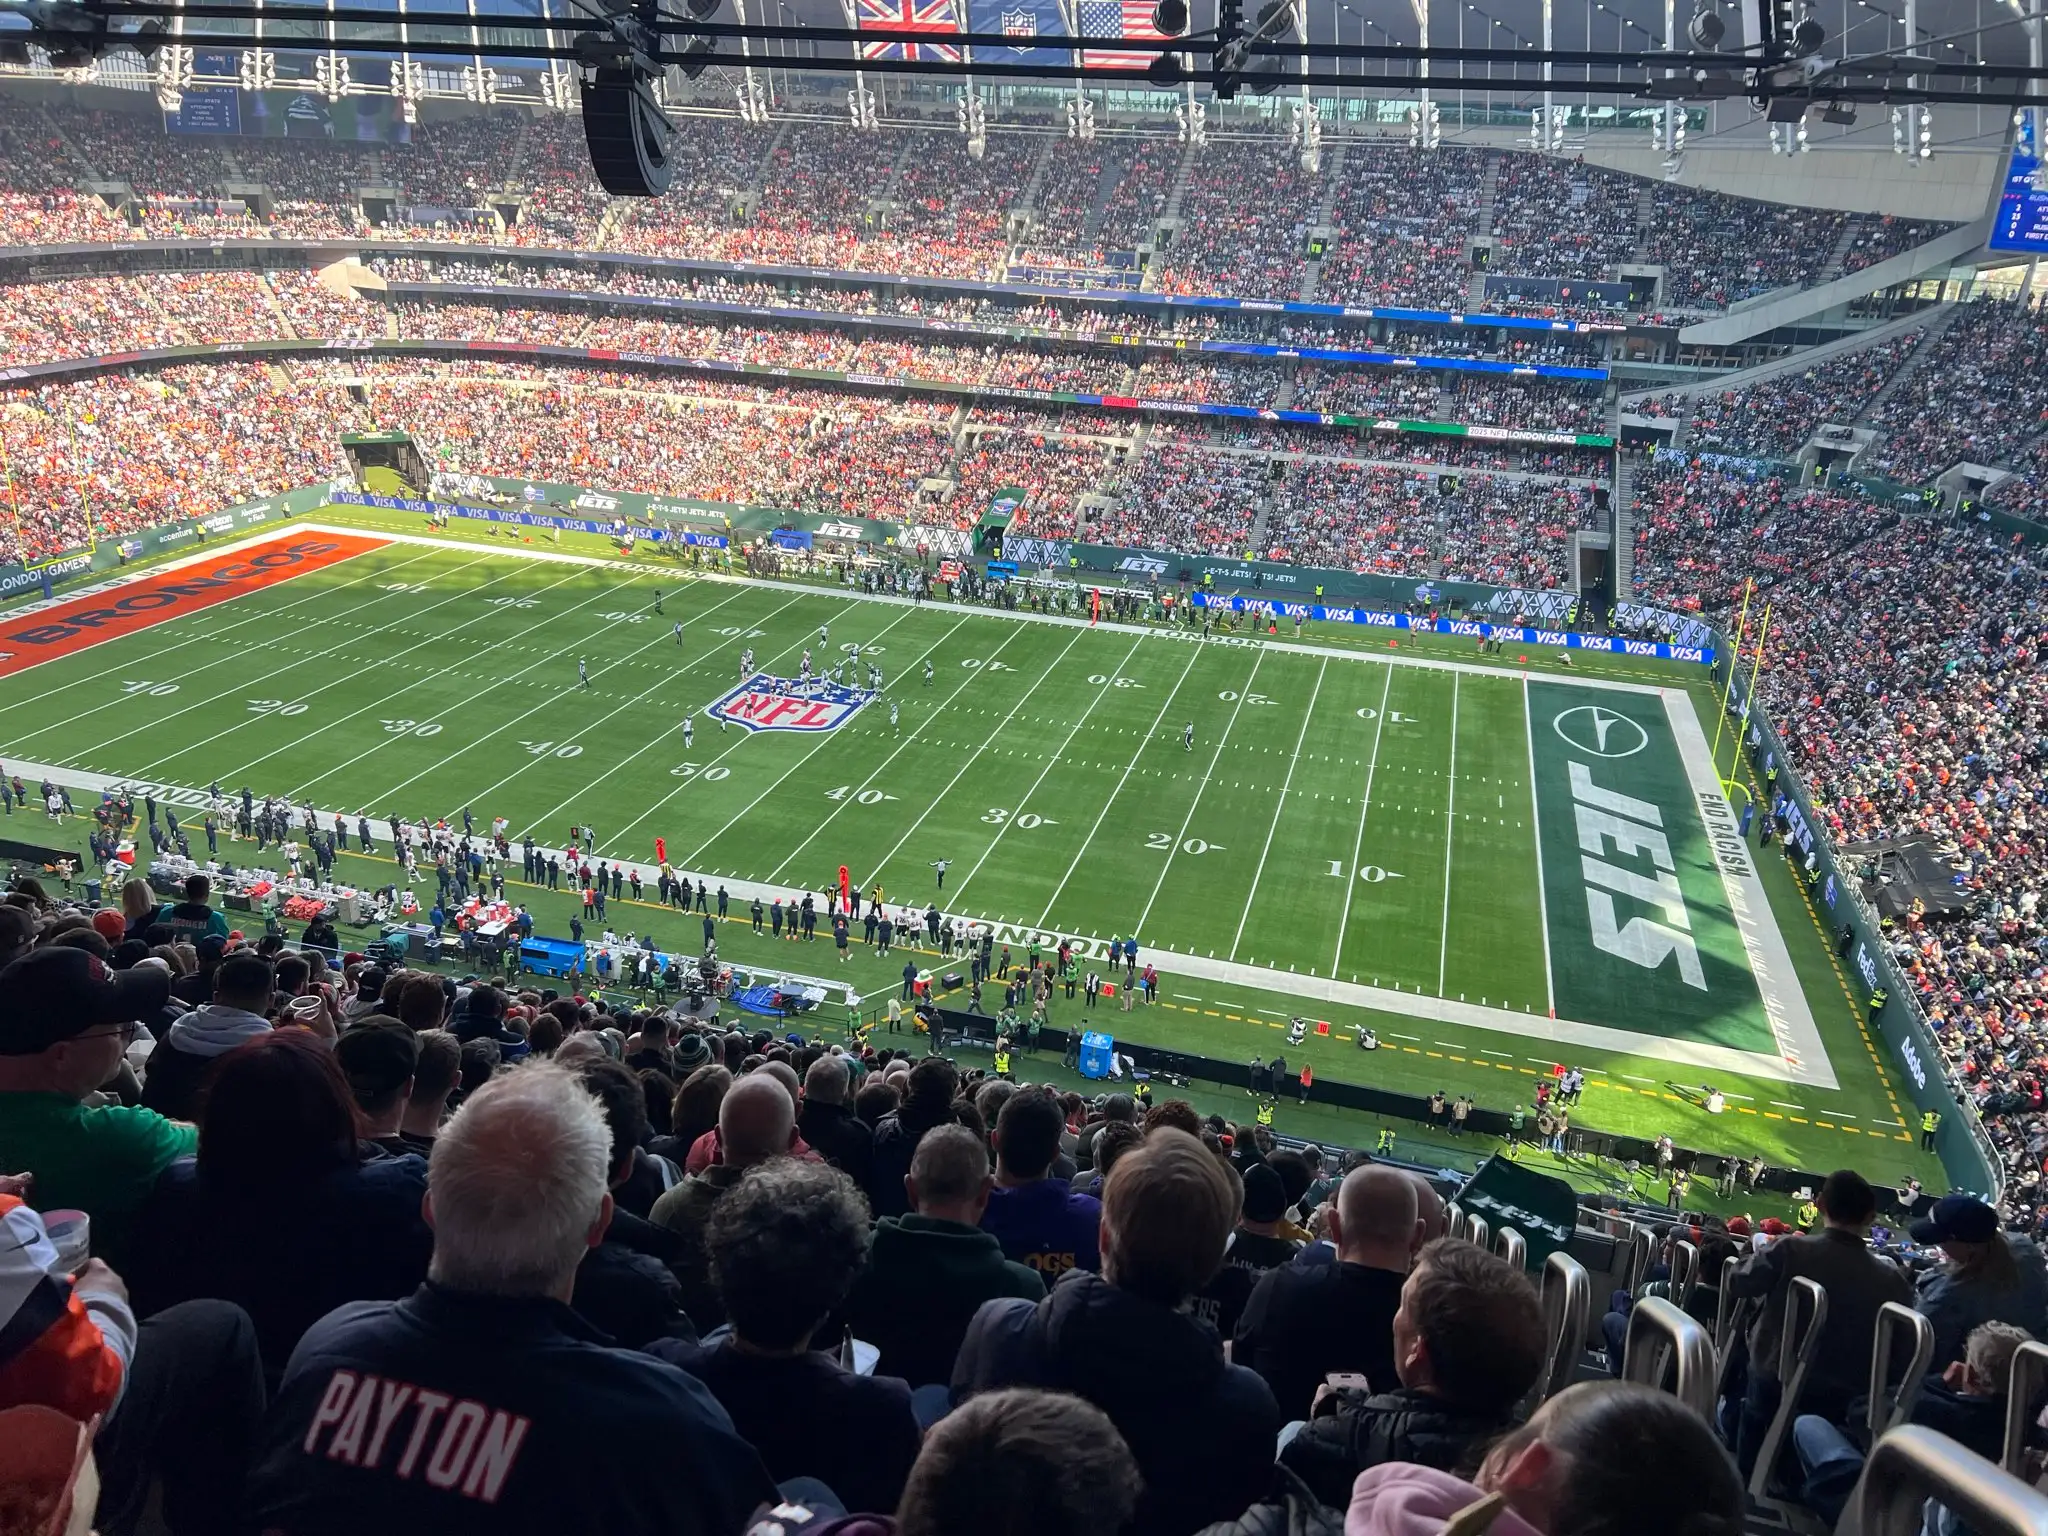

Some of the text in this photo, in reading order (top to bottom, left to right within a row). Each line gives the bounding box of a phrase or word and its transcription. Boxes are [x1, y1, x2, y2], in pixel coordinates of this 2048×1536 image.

[2015, 203, 2022, 212] 2
[2008, 230, 2015, 238] 0
[2010, 221, 2017, 229] 0
[1111, 336, 1123, 344] 1ST
[1130, 337, 1139, 345] 10
[1175, 340, 1186, 349] 44
[619, 352, 655, 363] BRONCOS
[733, 363, 745, 372] VS
[849, 375, 905, 386] NEW YORK JETS
[966, 386, 1052, 399] J-E-T-S JETS! JETS! JETS!
[1138, 401, 1171, 411] LONDON
[1172, 403, 1198, 412] GAMES
[1321, 415, 1334, 424] VS
[1470, 427, 1576, 443] 2025 NFL LONDON GAMES
[576, 490, 620, 510] JETS
[645, 503, 726, 518] J-E-T-S JETS! JETS! JETS!
[341, 493, 365, 505] VISA
[372, 497, 396, 509] VISA
[402, 501, 427, 513] VISA
[465, 508, 490, 520] VISA
[497, 511, 522, 524] VISA
[528, 514, 554, 527] VISA
[561, 518, 587, 531] VISA
[659, 530, 687, 544] VIA
[693, 534, 721, 547] VISA
[813, 519, 864, 539] JETS
[159, 528, 193, 543] accenture
[603, 561, 707, 578] LONDON
[1119, 553, 1169, 574] JETS
[0, 557, 85, 591] ONDO GAMES
[1203, 567, 1297, 583] J-E-T-S JETS! JTS! JETS!
[5, 541, 341, 645] BRONCOS
[1148, 628, 1265, 648] LONDON
[1242, 599, 1272, 613] VISA
[1323, 607, 1355, 621] VISA
[1364, 611, 1396, 626] VISA
[1449, 621, 1481, 635] VISA
[1534, 630, 1568, 645] VISA
[1578, 635, 1612, 650] VISA
[1624, 641, 1657, 656] VISA
[1668, 646, 1702, 661] VISA
[126, 680, 181, 697] 10
[248, 700, 310, 717] 20
[726, 693, 834, 727] NFL
[384, 719, 444, 737] 30
[525, 739, 584, 759] 40
[670, 762, 731, 782] 50
[824, 785, 886, 804] 40
[1699, 792, 1729, 818] END
[980, 807, 1043, 829] 30
[1144, 832, 1208, 855] 20
[1324, 859, 1387, 883] 10
[1567, 760, 1708, 992] JETS
[1319, 1024, 1328, 1033] 10
[1900, 1035, 1926, 1090] Adobe
[302, 1368, 533, 1504] PAYTON
